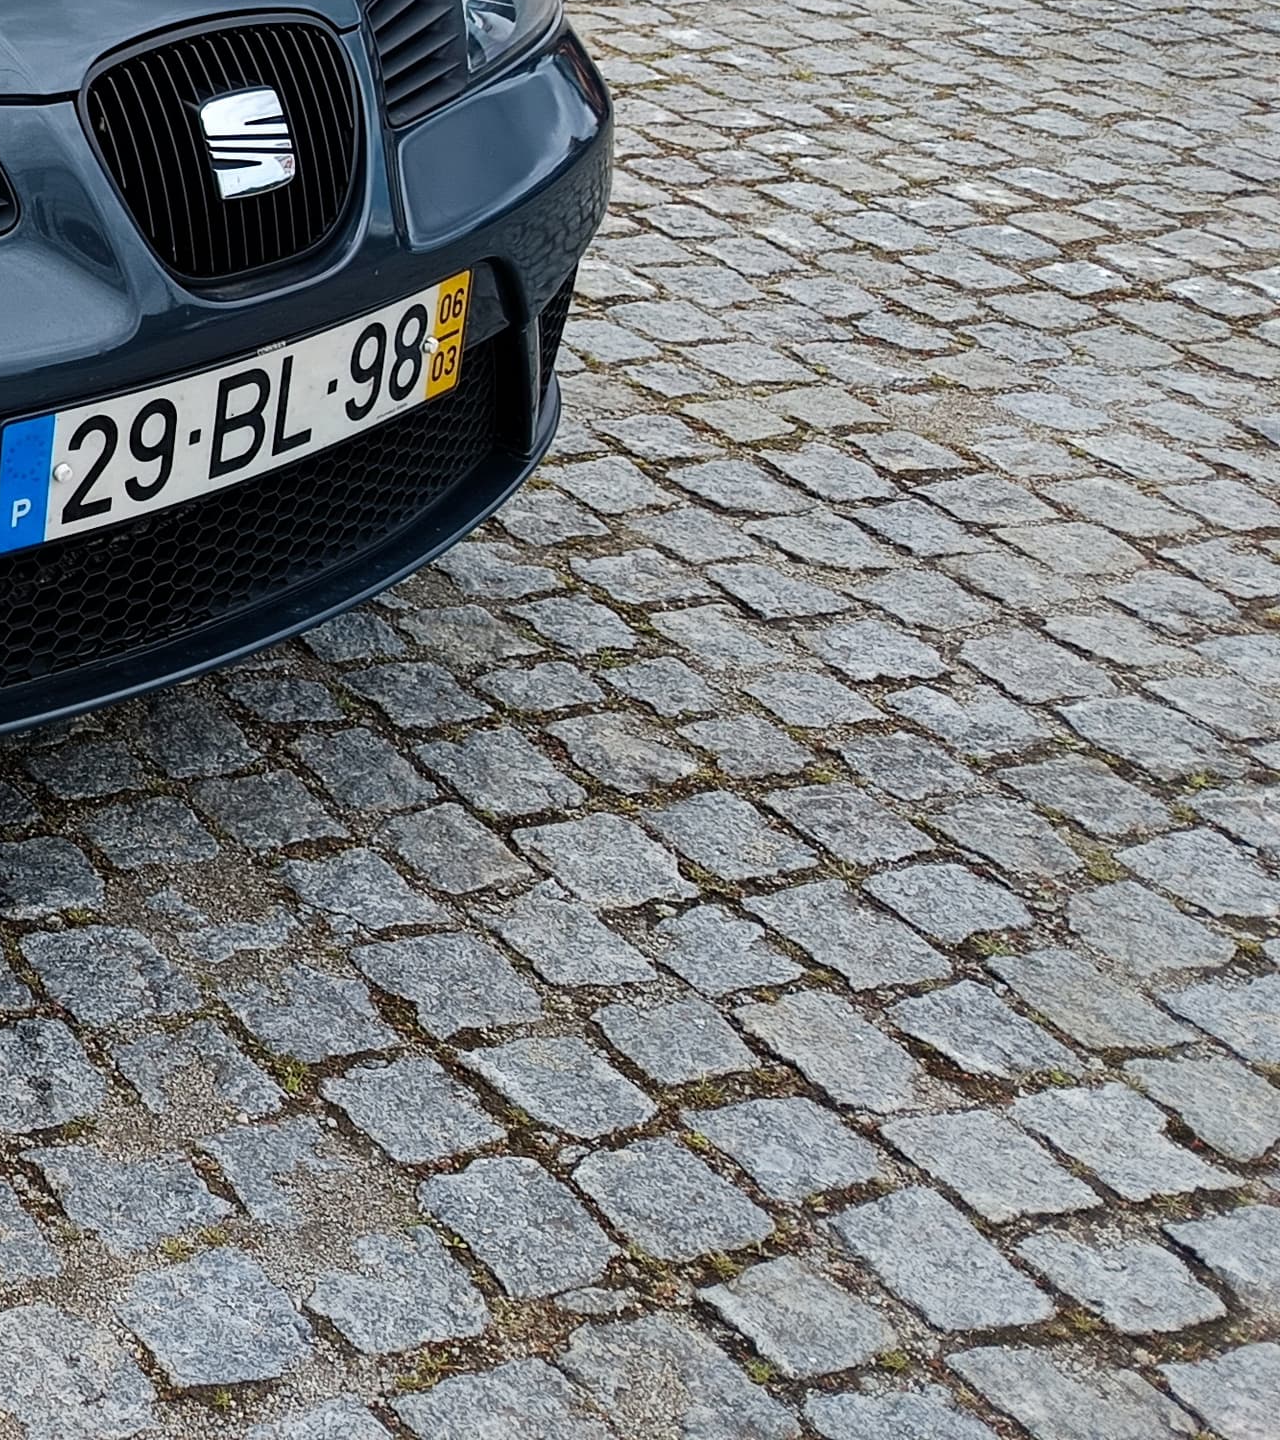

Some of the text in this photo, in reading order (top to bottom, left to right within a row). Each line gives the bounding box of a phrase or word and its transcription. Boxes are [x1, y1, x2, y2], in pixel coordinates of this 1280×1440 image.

[439, 288, 465, 324] 06
[432, 345, 457, 382] 03
[11, 498, 32, 528] P
